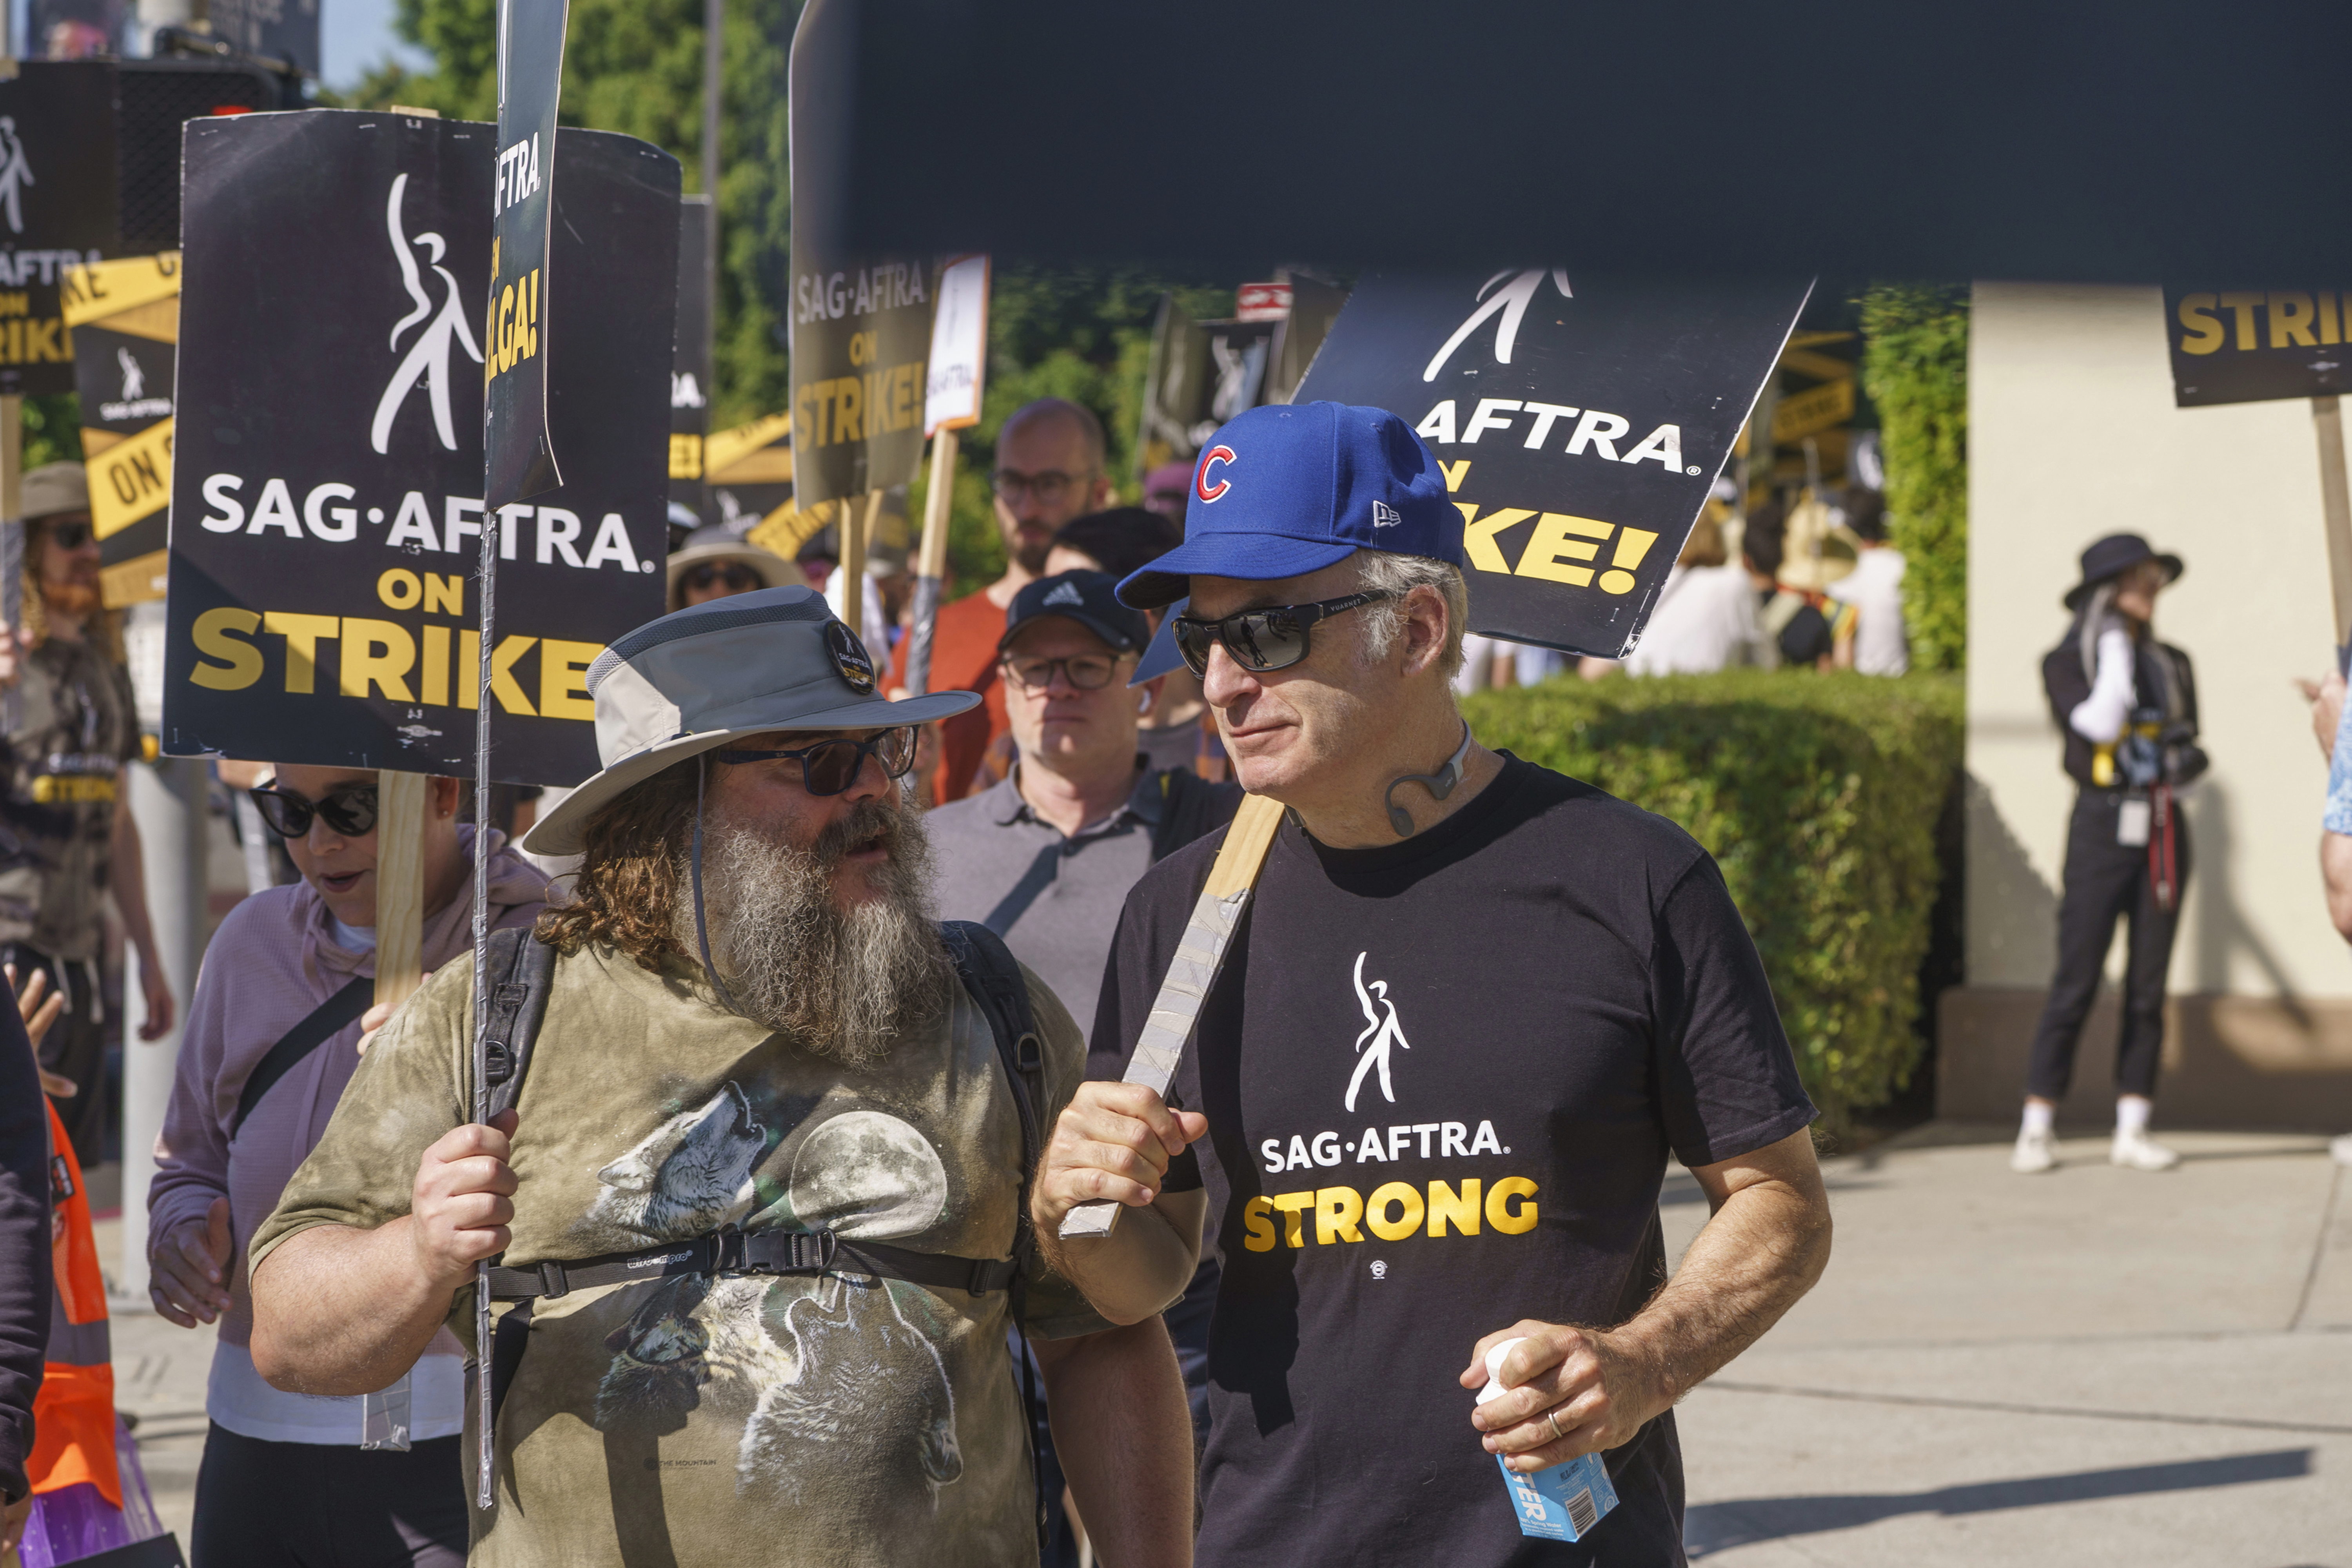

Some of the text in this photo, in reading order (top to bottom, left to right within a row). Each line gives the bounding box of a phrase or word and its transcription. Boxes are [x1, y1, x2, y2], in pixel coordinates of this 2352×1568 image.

[849, 330, 878, 367] ON
[794, 361, 925, 454] STRIKE!
[1196, 445, 1237, 504] C
[377, 568, 464, 616] ON
[1330, 598, 1361, 612] VUARNET
[189, 607, 606, 721] STRIKE
[1244, 1176, 1539, 1252] STRONG
